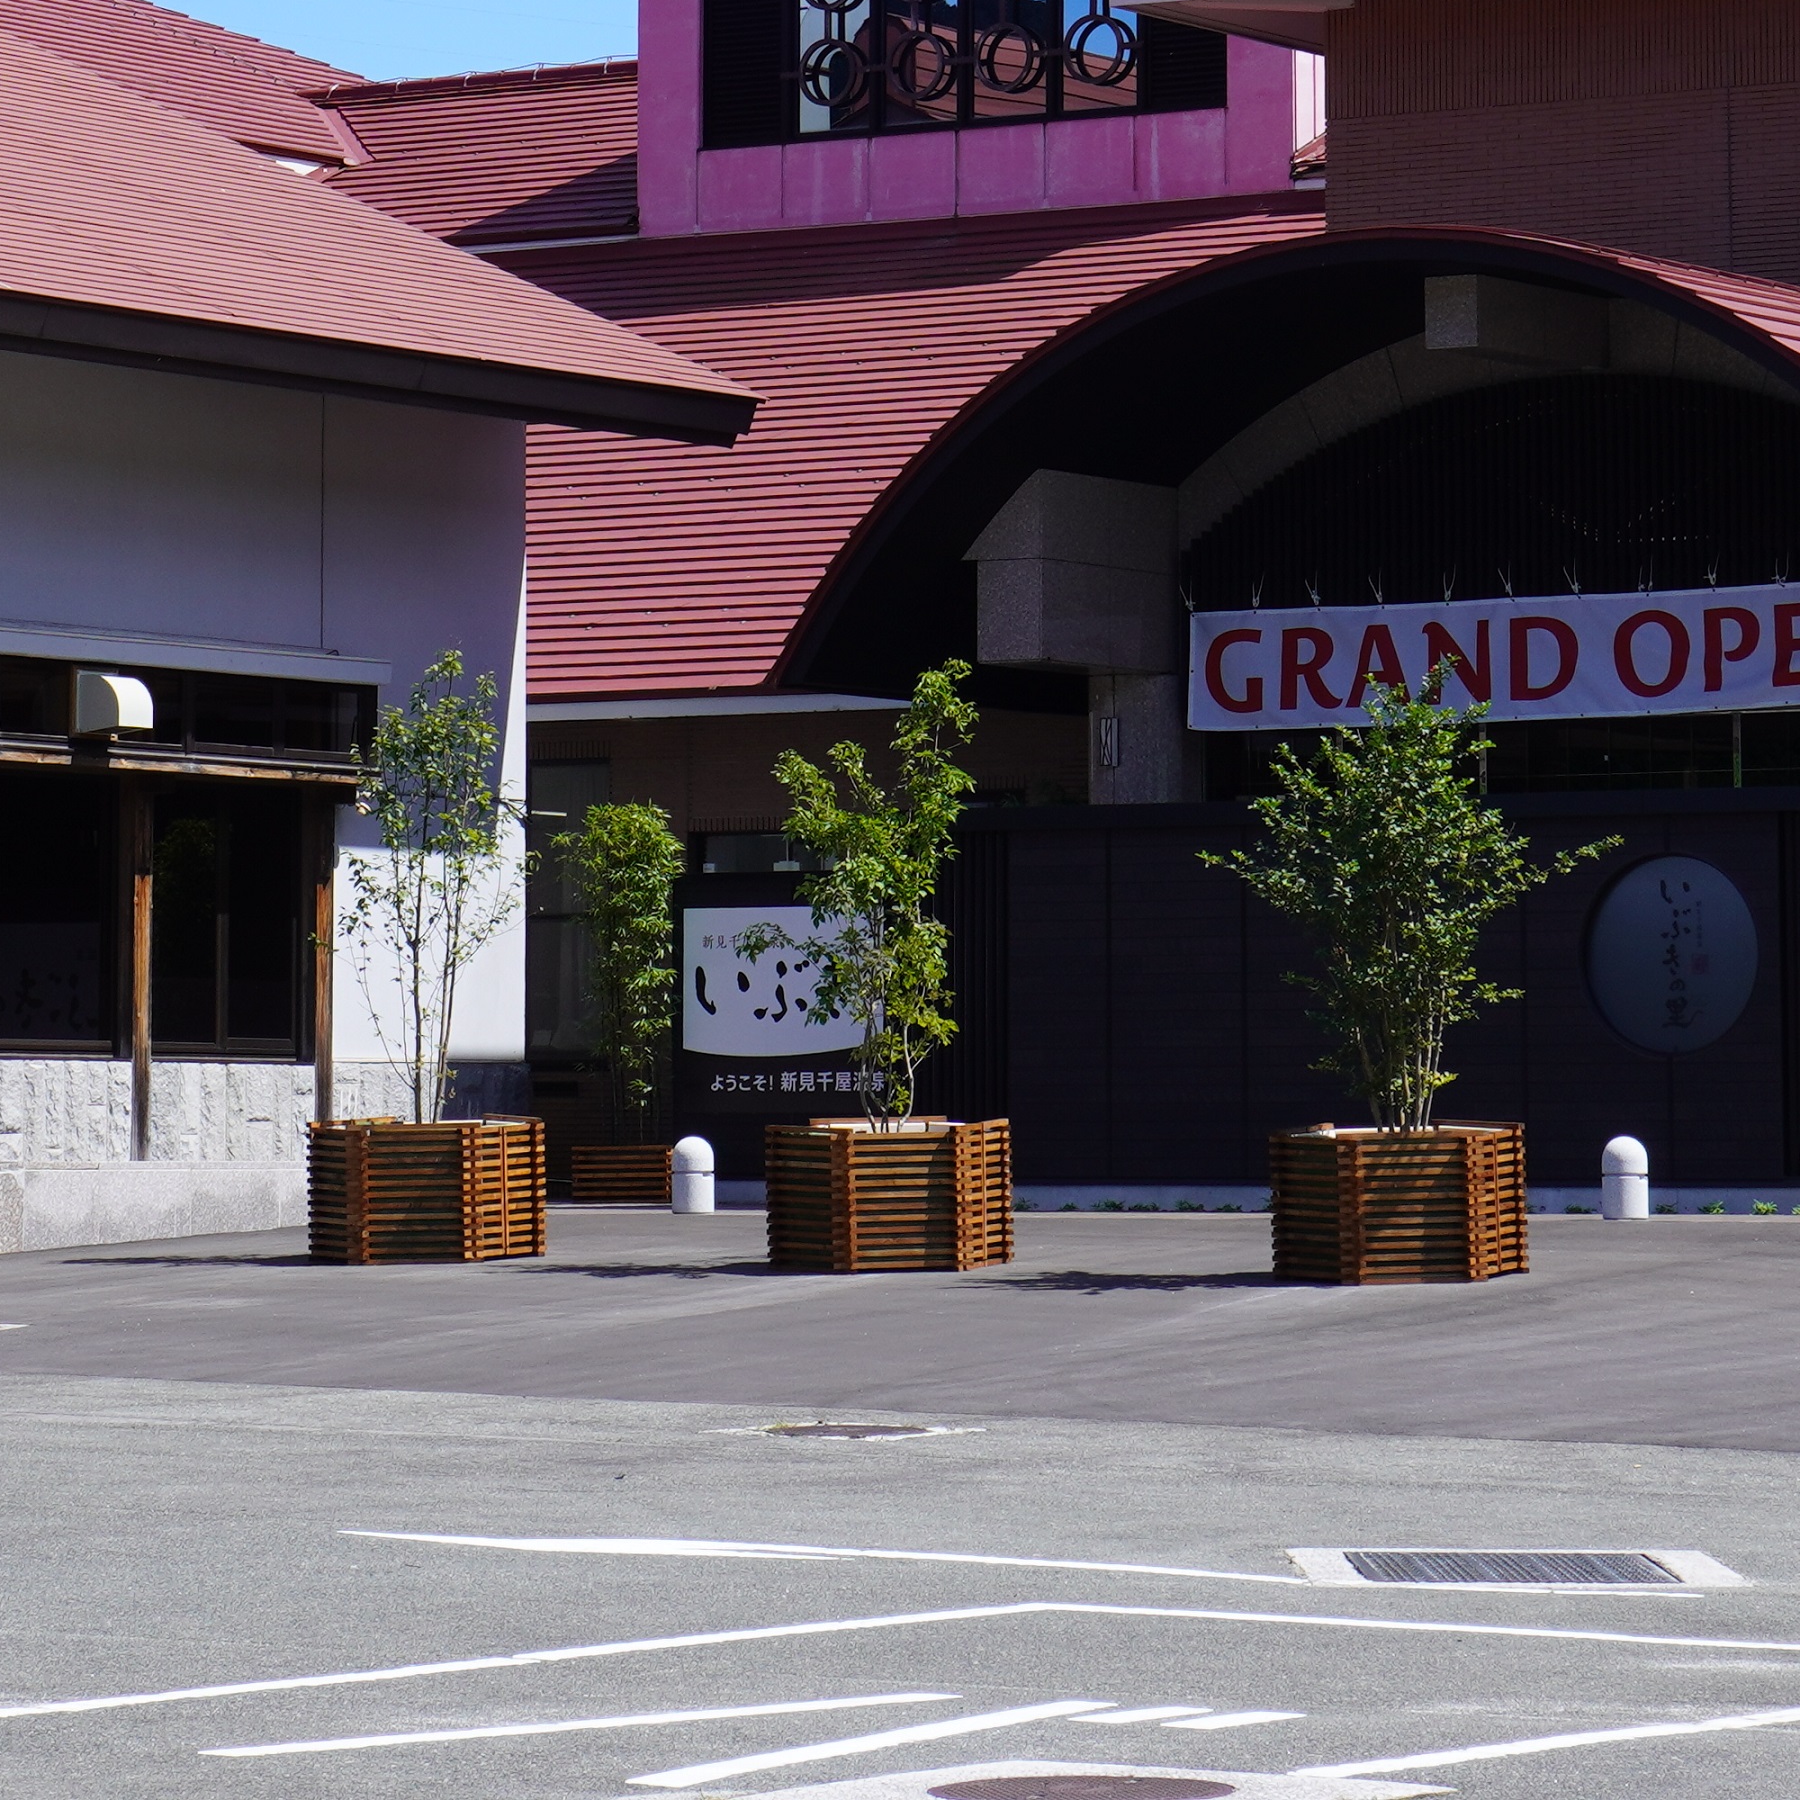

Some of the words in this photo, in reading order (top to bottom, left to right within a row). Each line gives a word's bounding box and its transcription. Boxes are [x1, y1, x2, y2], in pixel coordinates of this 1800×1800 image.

[1205, 616, 1579, 714] GRAND
[710, 1074, 774, 1092] ようこそ!
